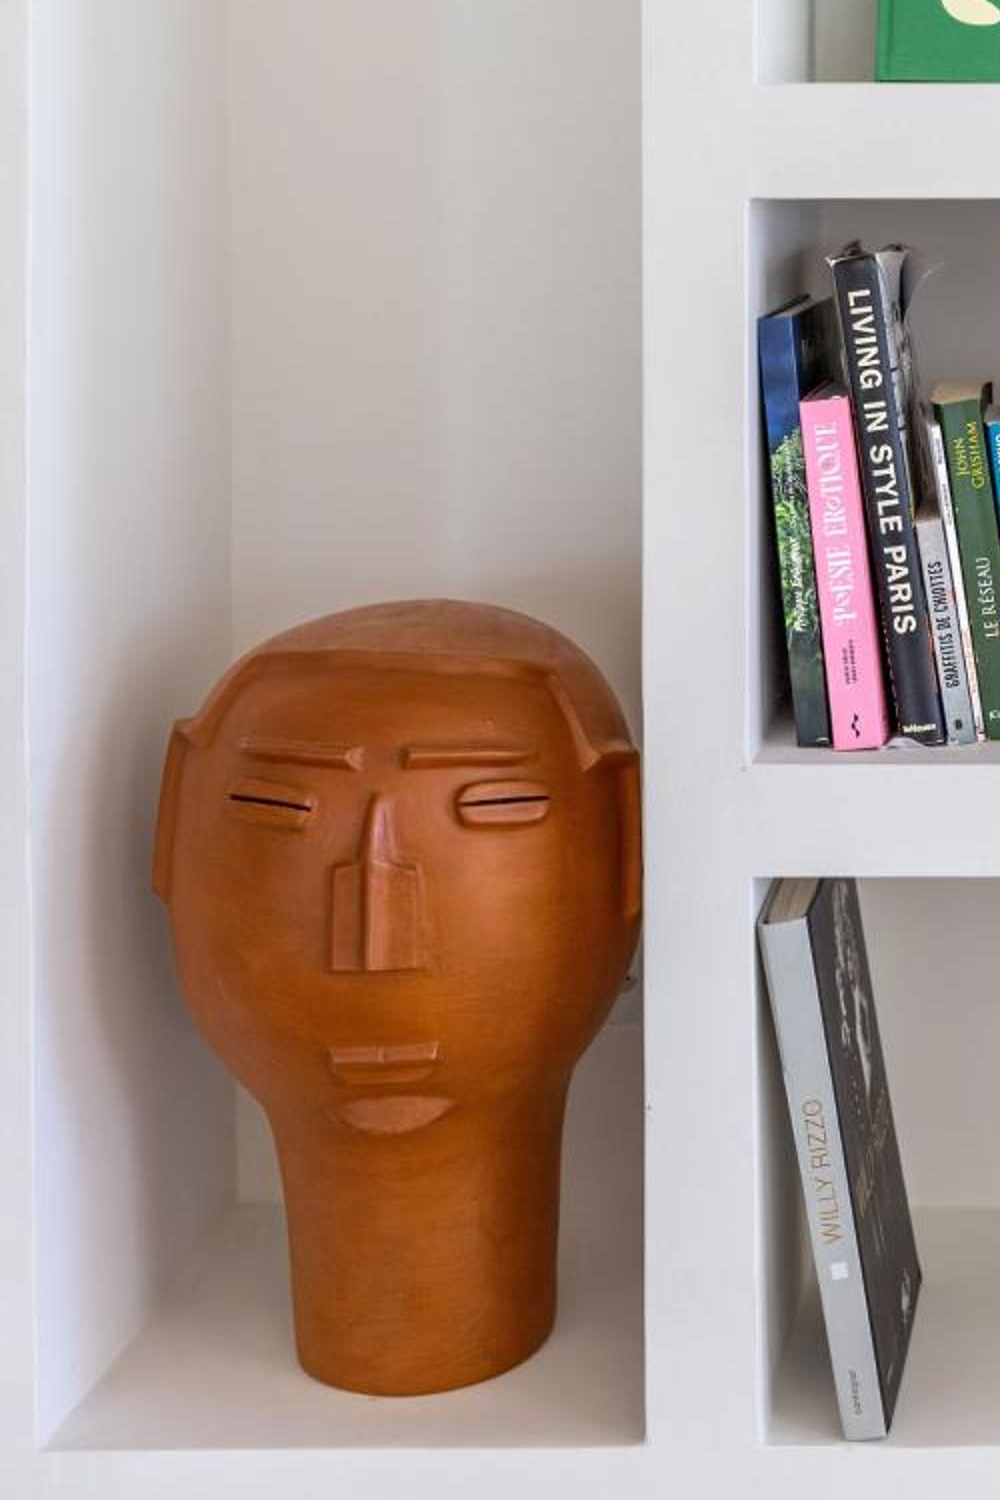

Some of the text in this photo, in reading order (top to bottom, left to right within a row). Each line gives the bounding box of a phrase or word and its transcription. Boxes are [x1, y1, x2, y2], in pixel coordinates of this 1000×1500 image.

[848, 289, 917, 634] LIVING IN STYLE PARIS
[954, 438, 968, 475] JOHN
[967, 421, 985, 489] GRISHAM
[928, 560, 960, 688] GRAFFITIS DE CHIOTTES
[976, 557, 999, 638] LE RÉSEAU
[802, 1098, 843, 1246] WILLY RIZZO
